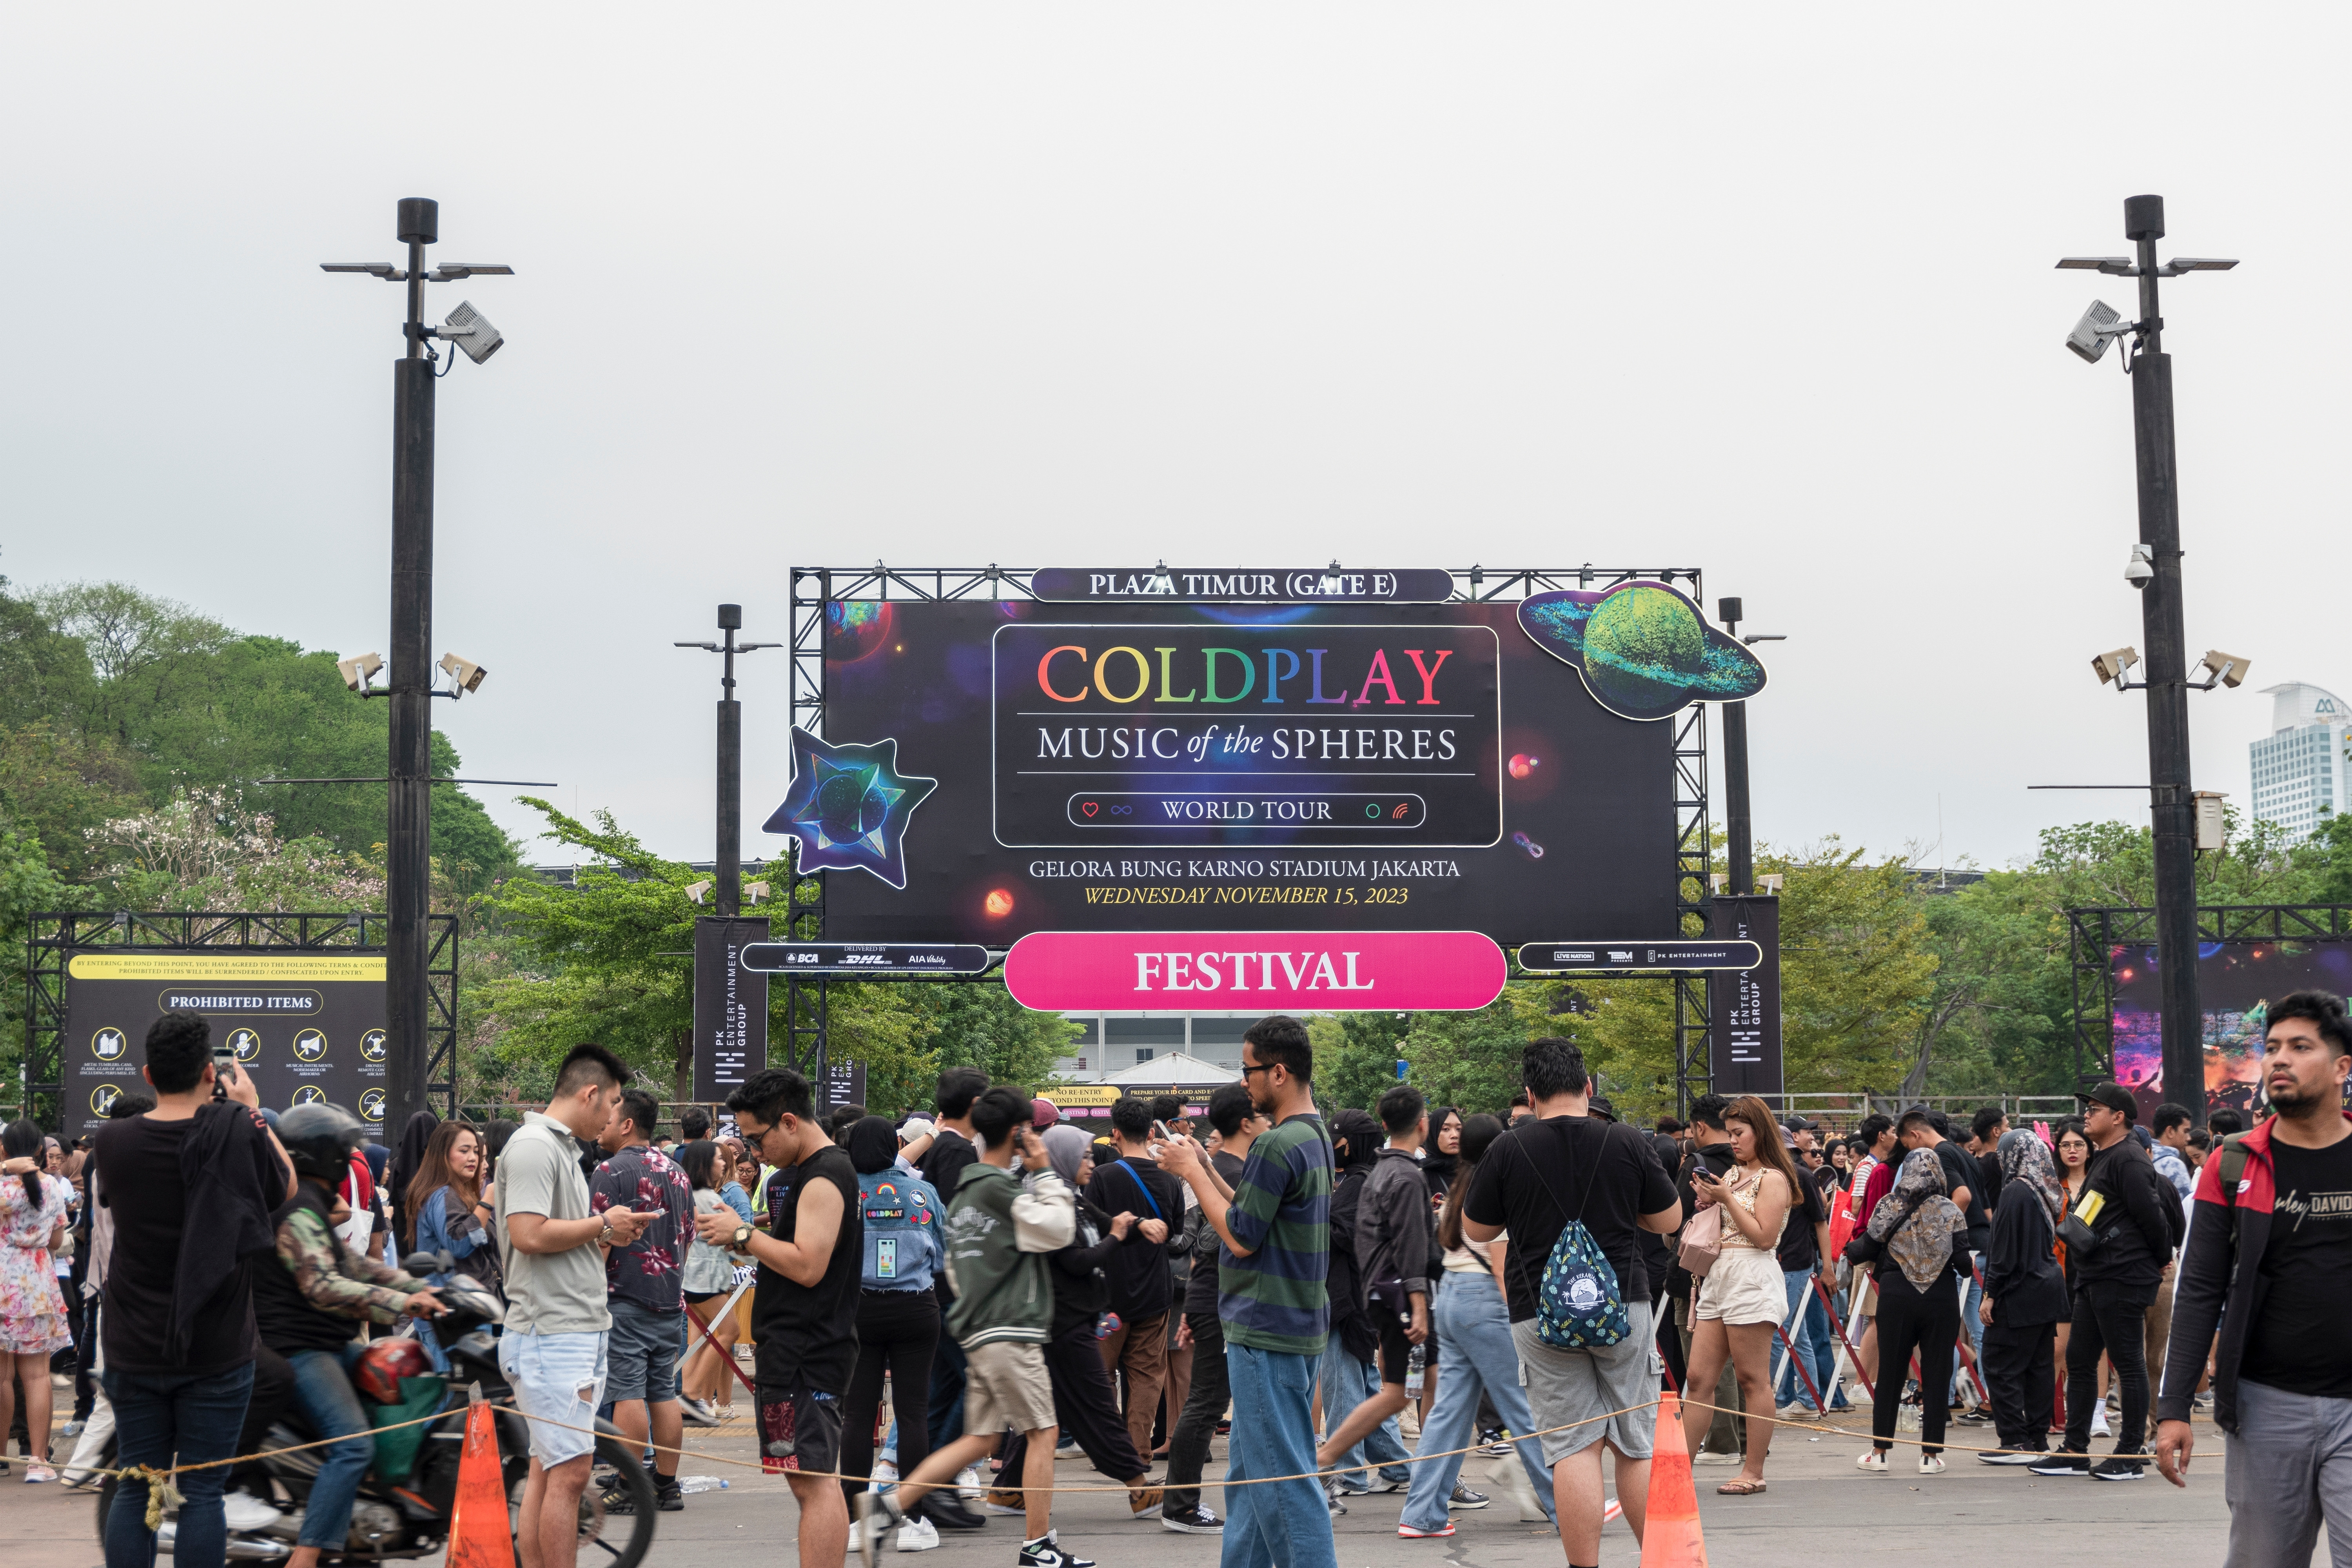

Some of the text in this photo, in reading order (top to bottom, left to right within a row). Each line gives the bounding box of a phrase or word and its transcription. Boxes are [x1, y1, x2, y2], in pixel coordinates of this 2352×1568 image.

[1090, 572, 1396, 597] PLAZA TIMUR (GATE E)
[1038, 646, 1453, 704] COLDPLAY
[1037, 725, 1455, 762] MUSIC of the SPHERES
[1161, 801, 1332, 819] WORLD TOUR
[1030, 860, 1461, 880] GELORA BUNG KARNO STADIUM JAKARTA
[1085, 887, 1408, 905] WEDNESDAY NOVEMBER 15, 2023
[797, 954, 818, 963] BCA
[845, 955, 885, 964] DHL
[927, 954, 946, 965] Vitality
[1133, 951, 1375, 991] FESTIVAL
[170, 996, 312, 1009] PROHIBITED ITEMS
[727, 944, 736, 1045] ENTERTAINMENT
[1751, 983, 1760, 1025] GROUP
[738, 1004, 746, 1046] GROUP
[1731, 1010, 1739, 1025] PK
[716, 1031, 724, 1045] PK
[831, 1066, 837, 1077] PK
[867, 1209, 903, 1218] COLDPLAY
[2274, 1189, 2352, 1232] rley DAVID
[1567, 1276, 1577, 1285] THE
